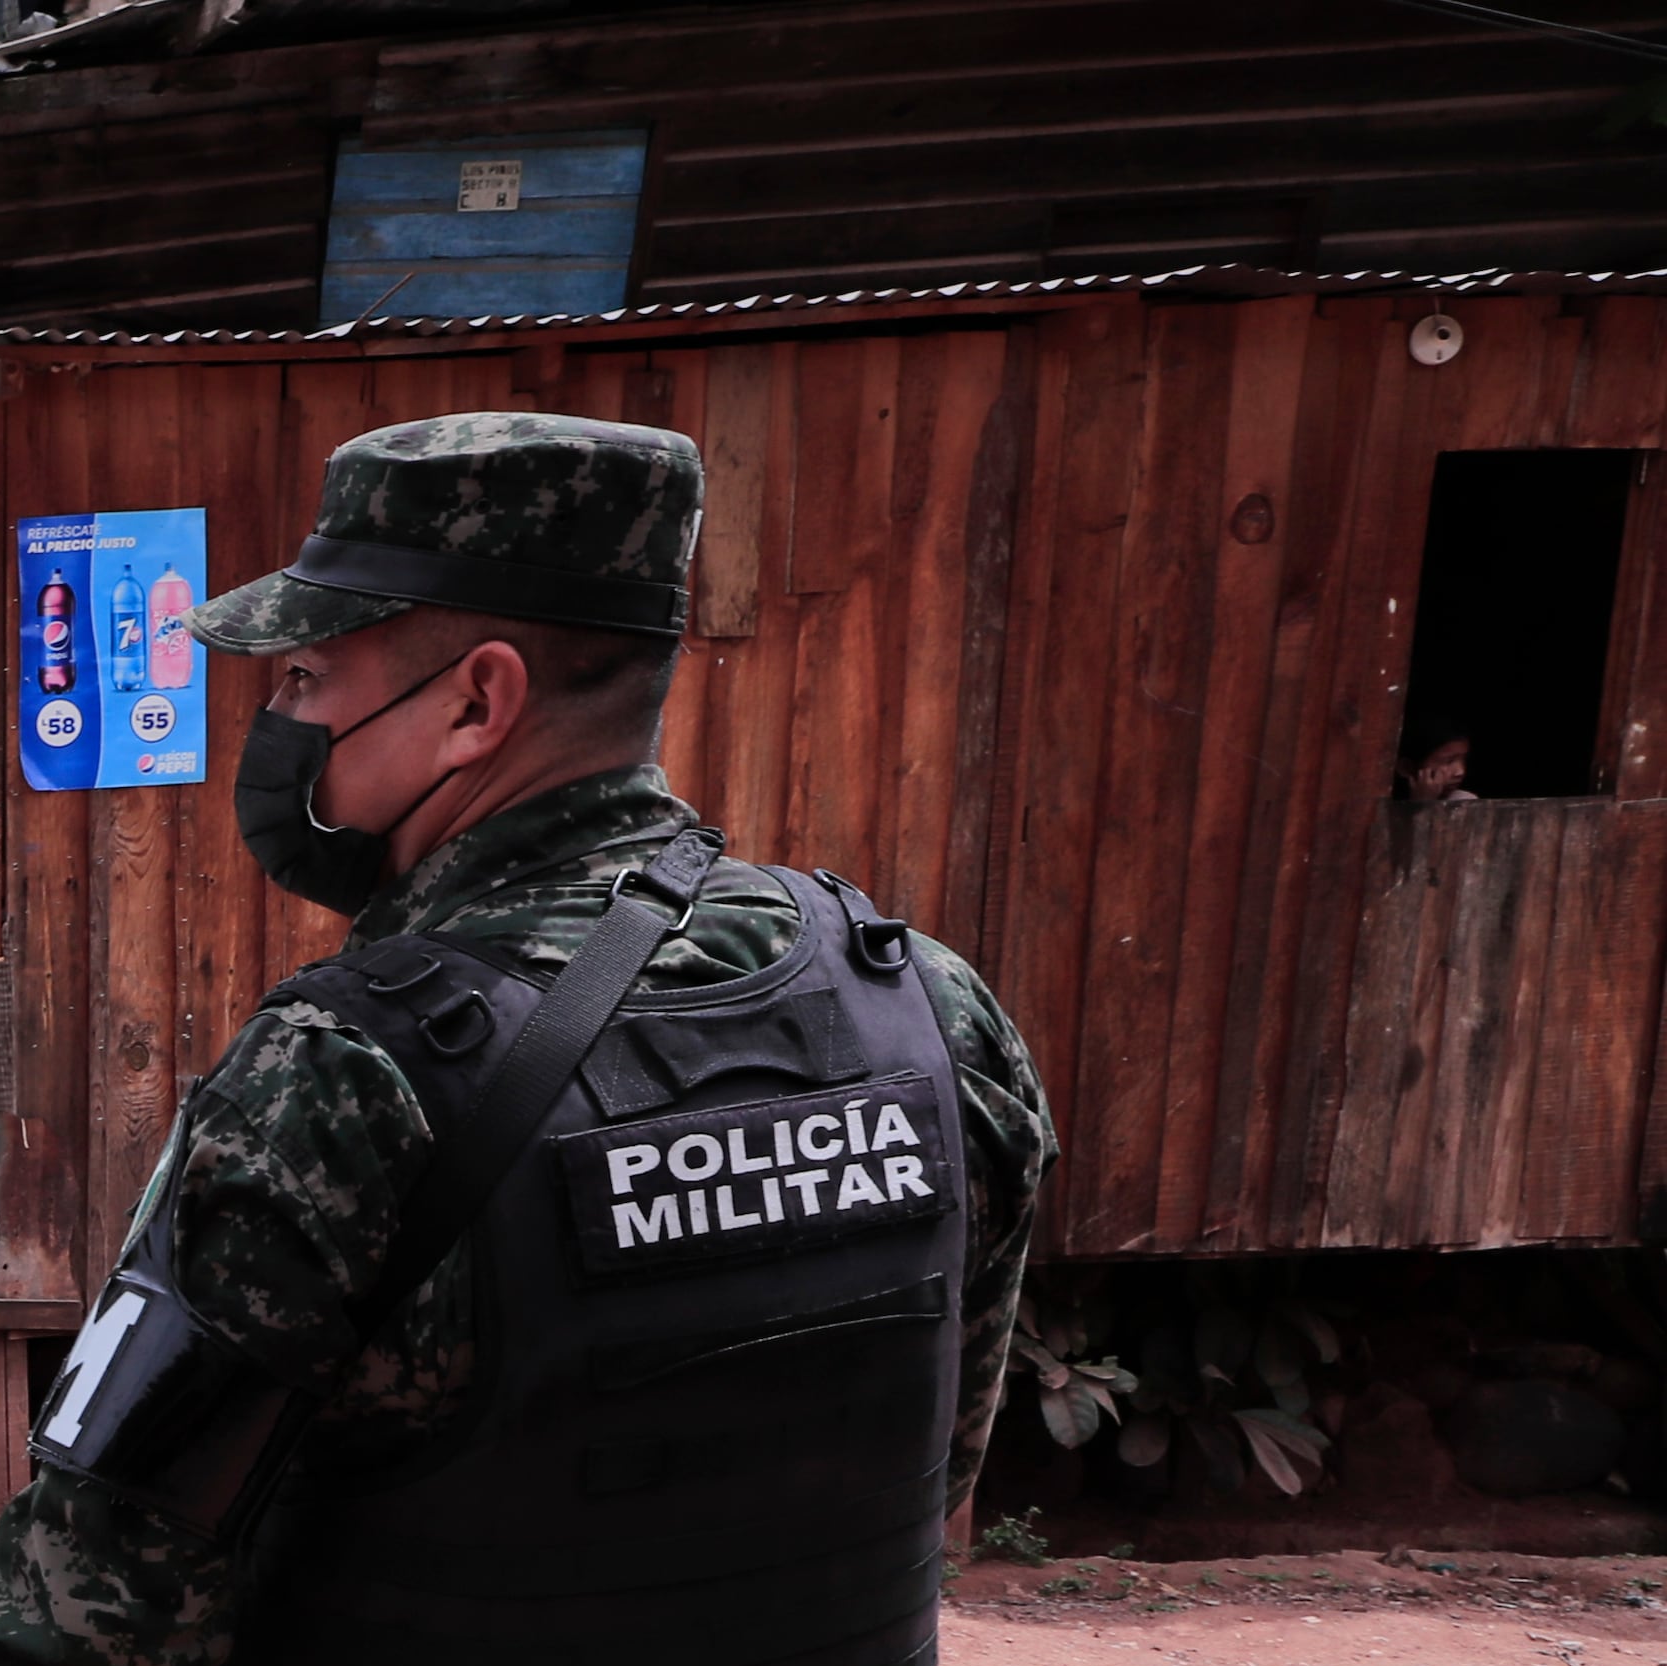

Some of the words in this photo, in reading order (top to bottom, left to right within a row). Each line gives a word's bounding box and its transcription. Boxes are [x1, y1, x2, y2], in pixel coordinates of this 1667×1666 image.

[27, 541, 45, 554] AL
[46, 538, 95, 553] PRECIO
[97, 537, 136, 550] JUSTO
[156, 760, 197, 774] PEPSI
[606, 1099, 921, 1195] POLICÍA
[611, 1155, 936, 1249] MILITAR
